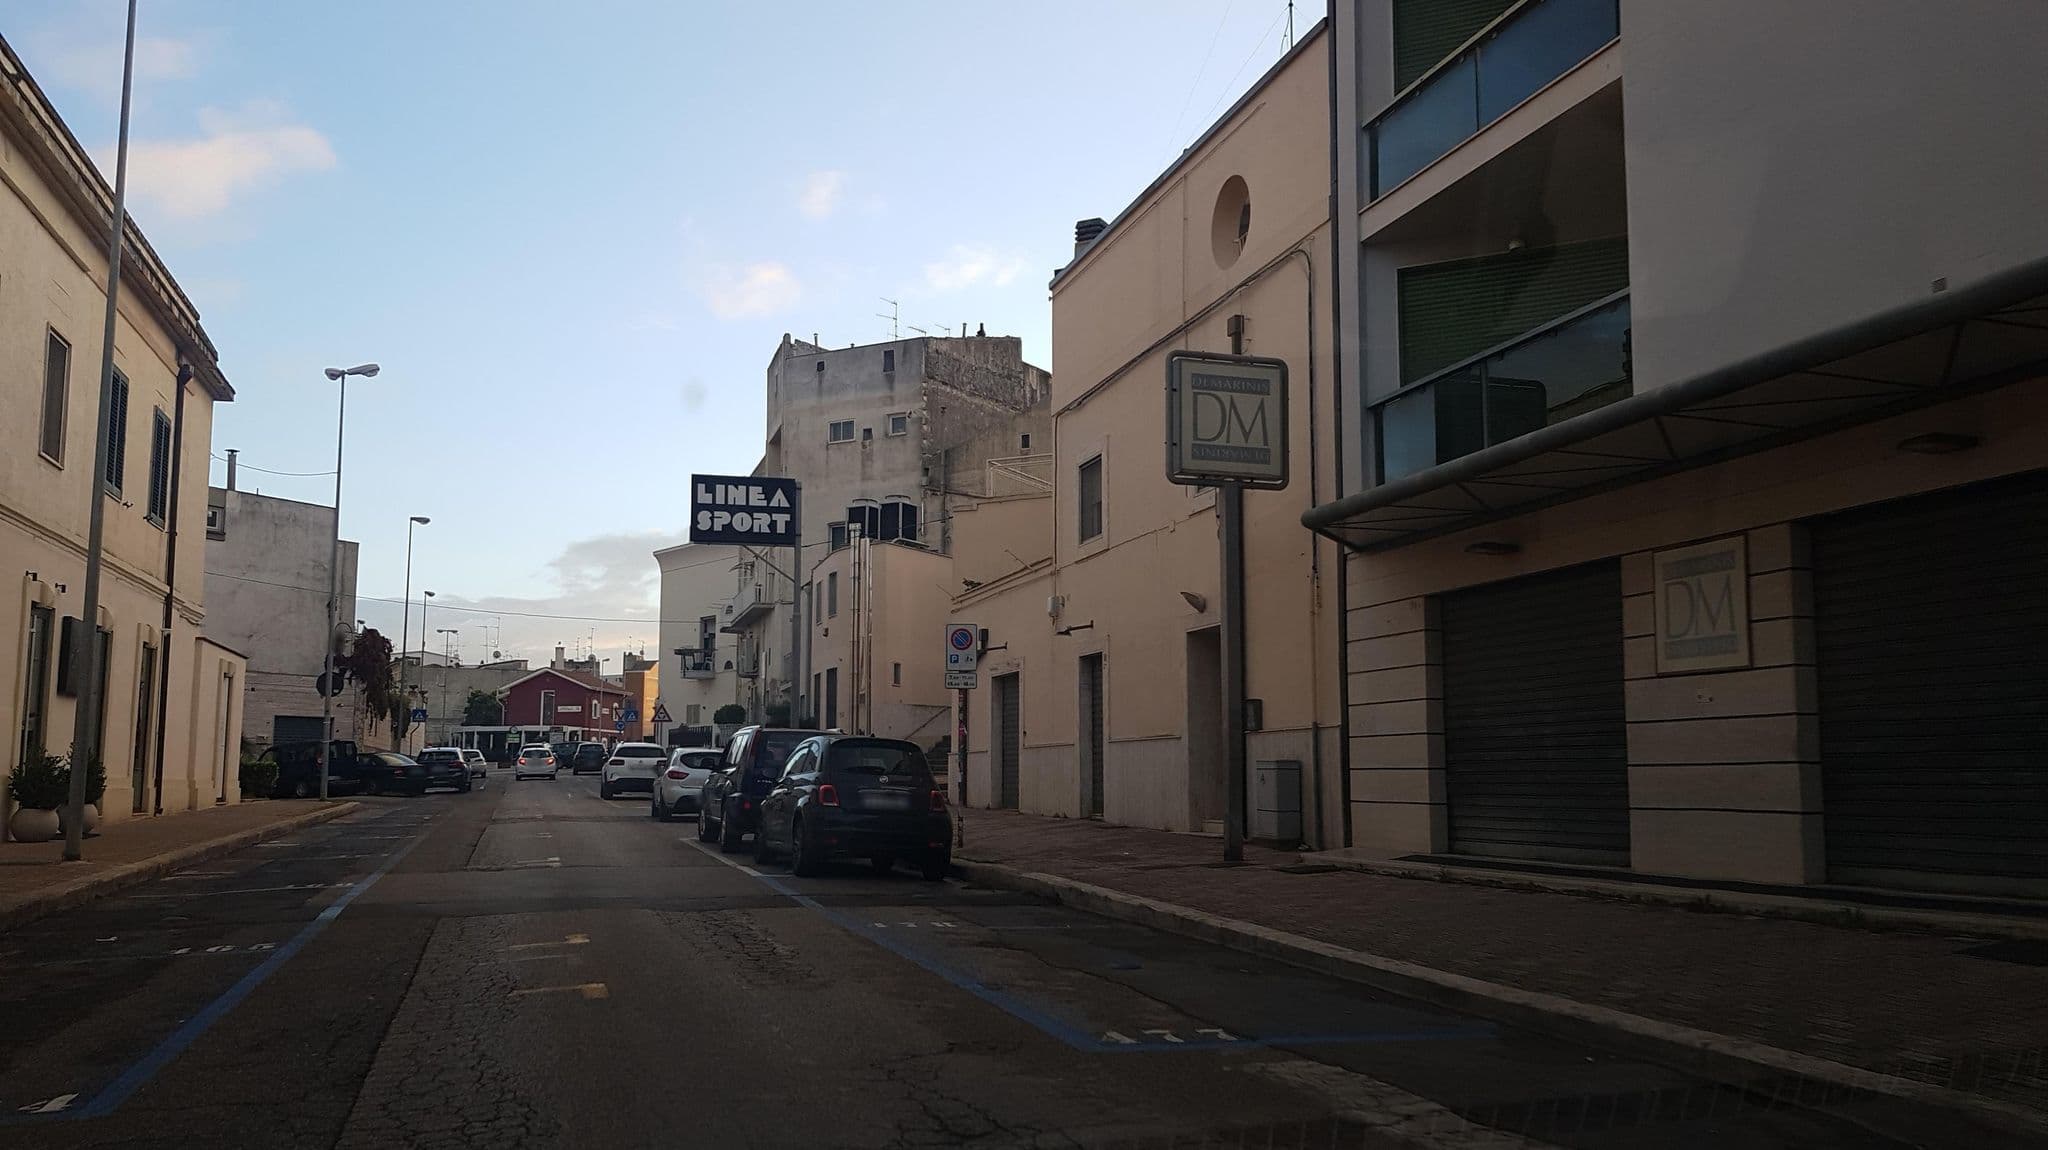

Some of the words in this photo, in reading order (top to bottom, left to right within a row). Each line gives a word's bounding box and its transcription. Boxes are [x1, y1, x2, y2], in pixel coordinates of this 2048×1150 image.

[1193, 391, 1269, 446] DM
[696, 483, 791, 507] LINEA
[696, 510, 791, 534] SPORT
[1664, 574, 1735, 638] DM
